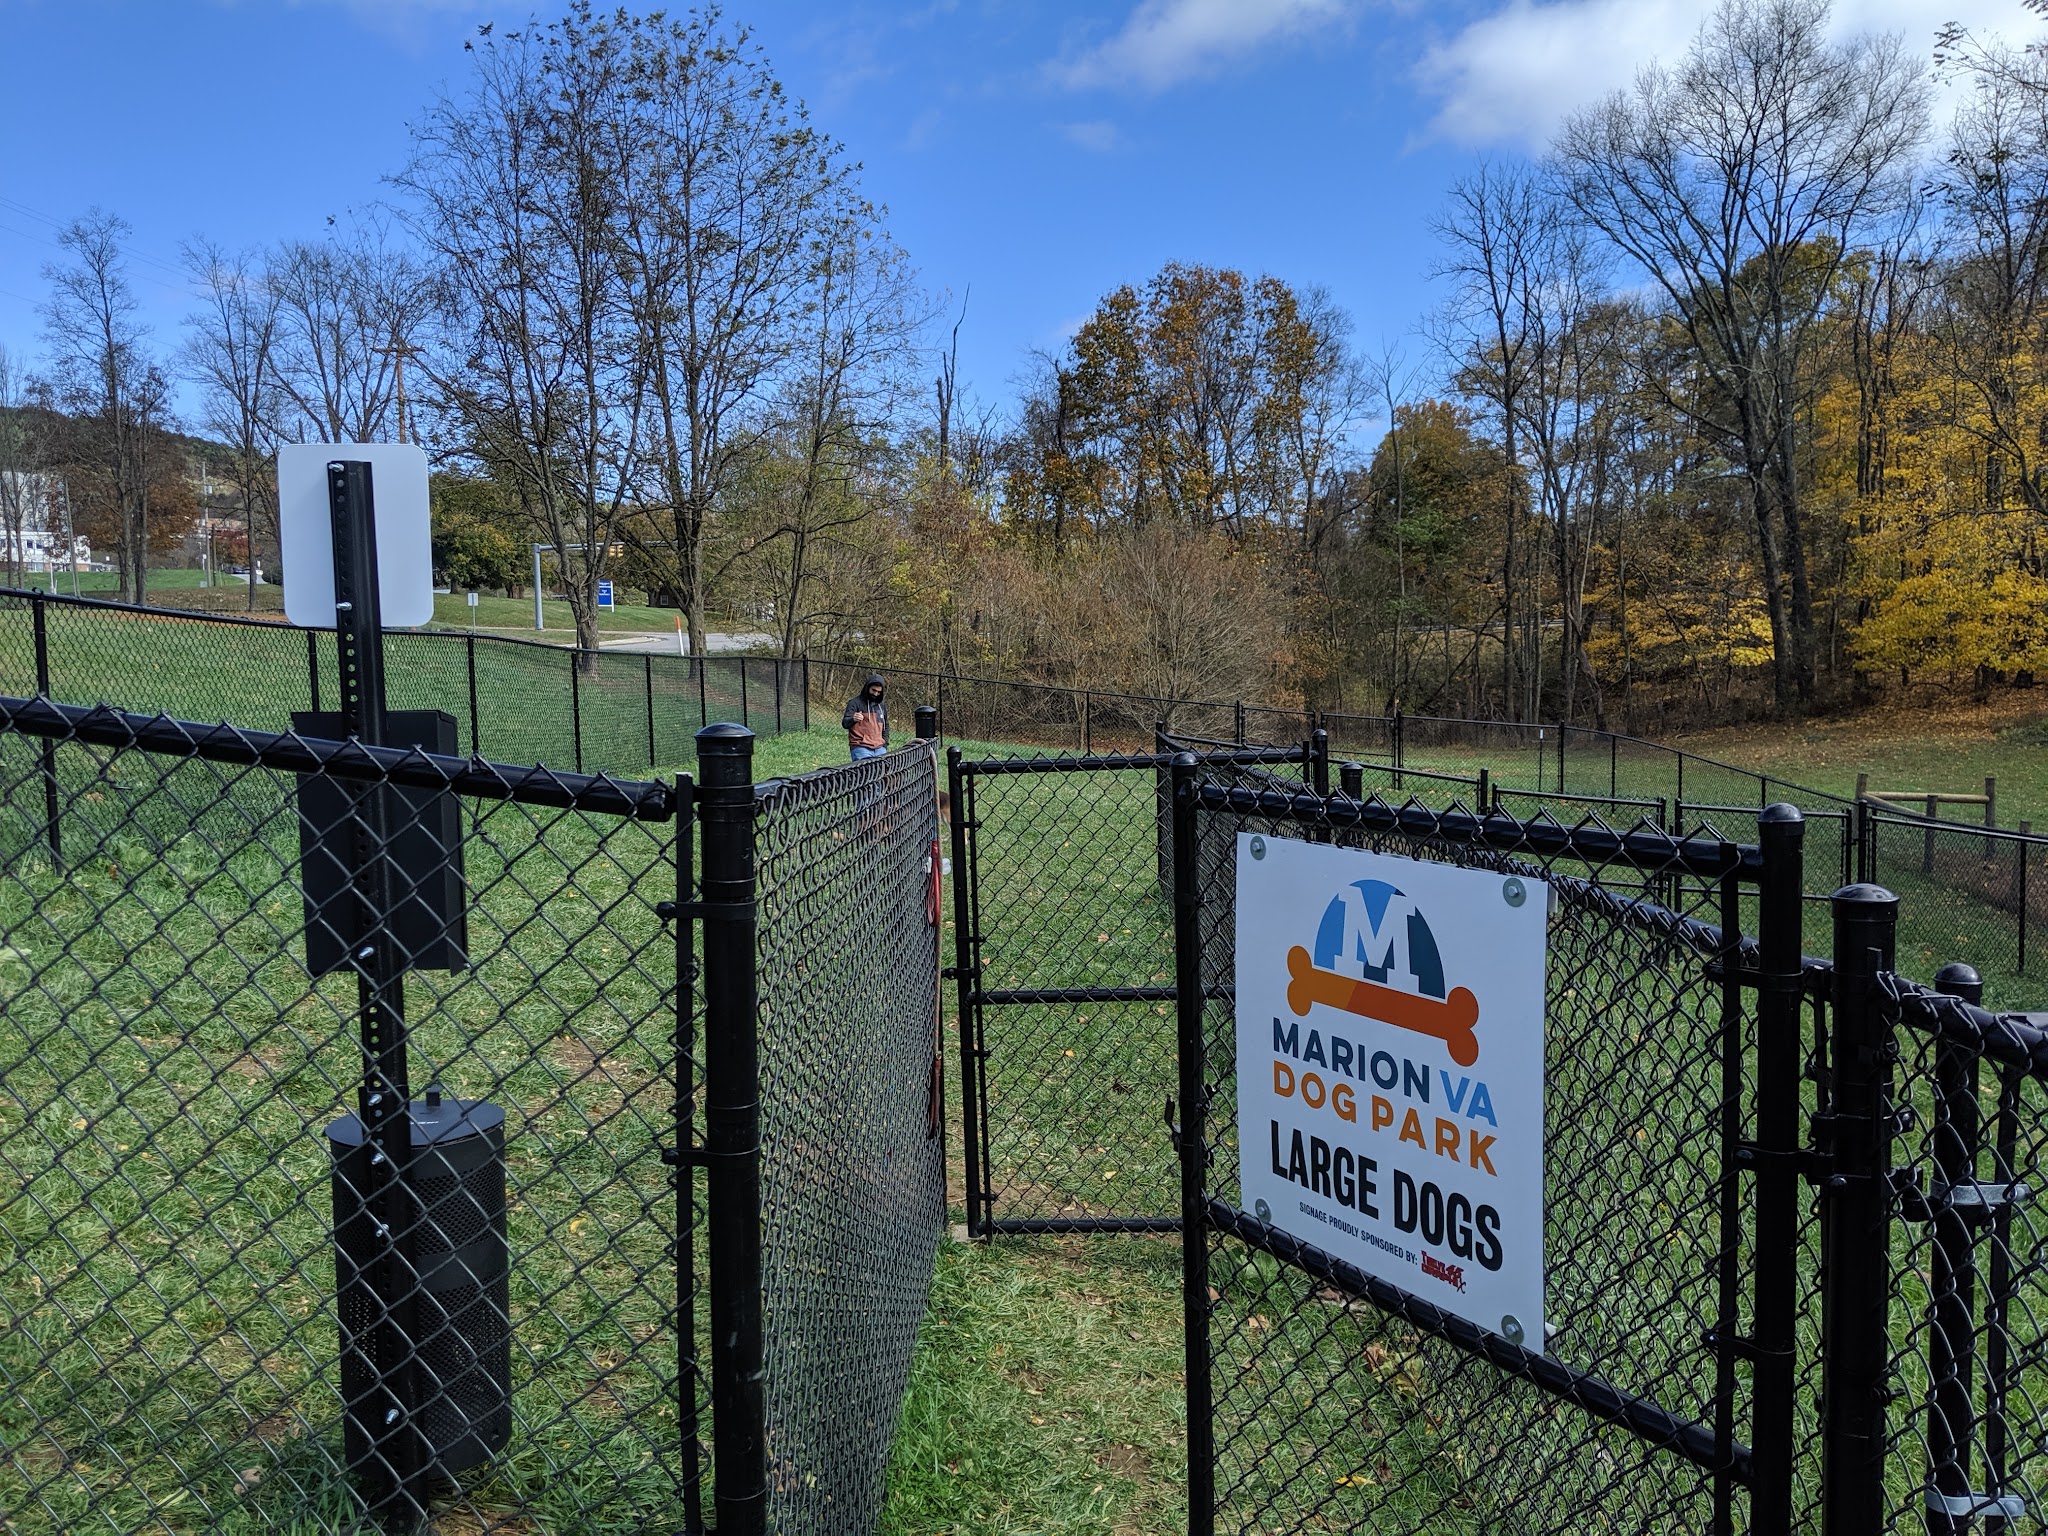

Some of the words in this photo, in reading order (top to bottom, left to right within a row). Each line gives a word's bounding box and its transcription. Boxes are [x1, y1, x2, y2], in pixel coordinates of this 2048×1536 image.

[1334, 884, 1420, 993] M
[1272, 1016, 1430, 1105] MARION
[1439, 1069, 1499, 1128] VA
[1273, 1060, 1357, 1124] DOG
[1371, 1094, 1499, 1177] PARK
[1270, 1118, 1380, 1221] LARGE
[1393, 1168, 1504, 1272] DOGS
[1299, 1201, 1327, 1224] SIGNAGE
[1328, 1213, 1359, 1238] PROUDLY
[1360, 1229, 1404, 1259] SPONSORED
[1405, 1249, 1418, 1266] BY:
